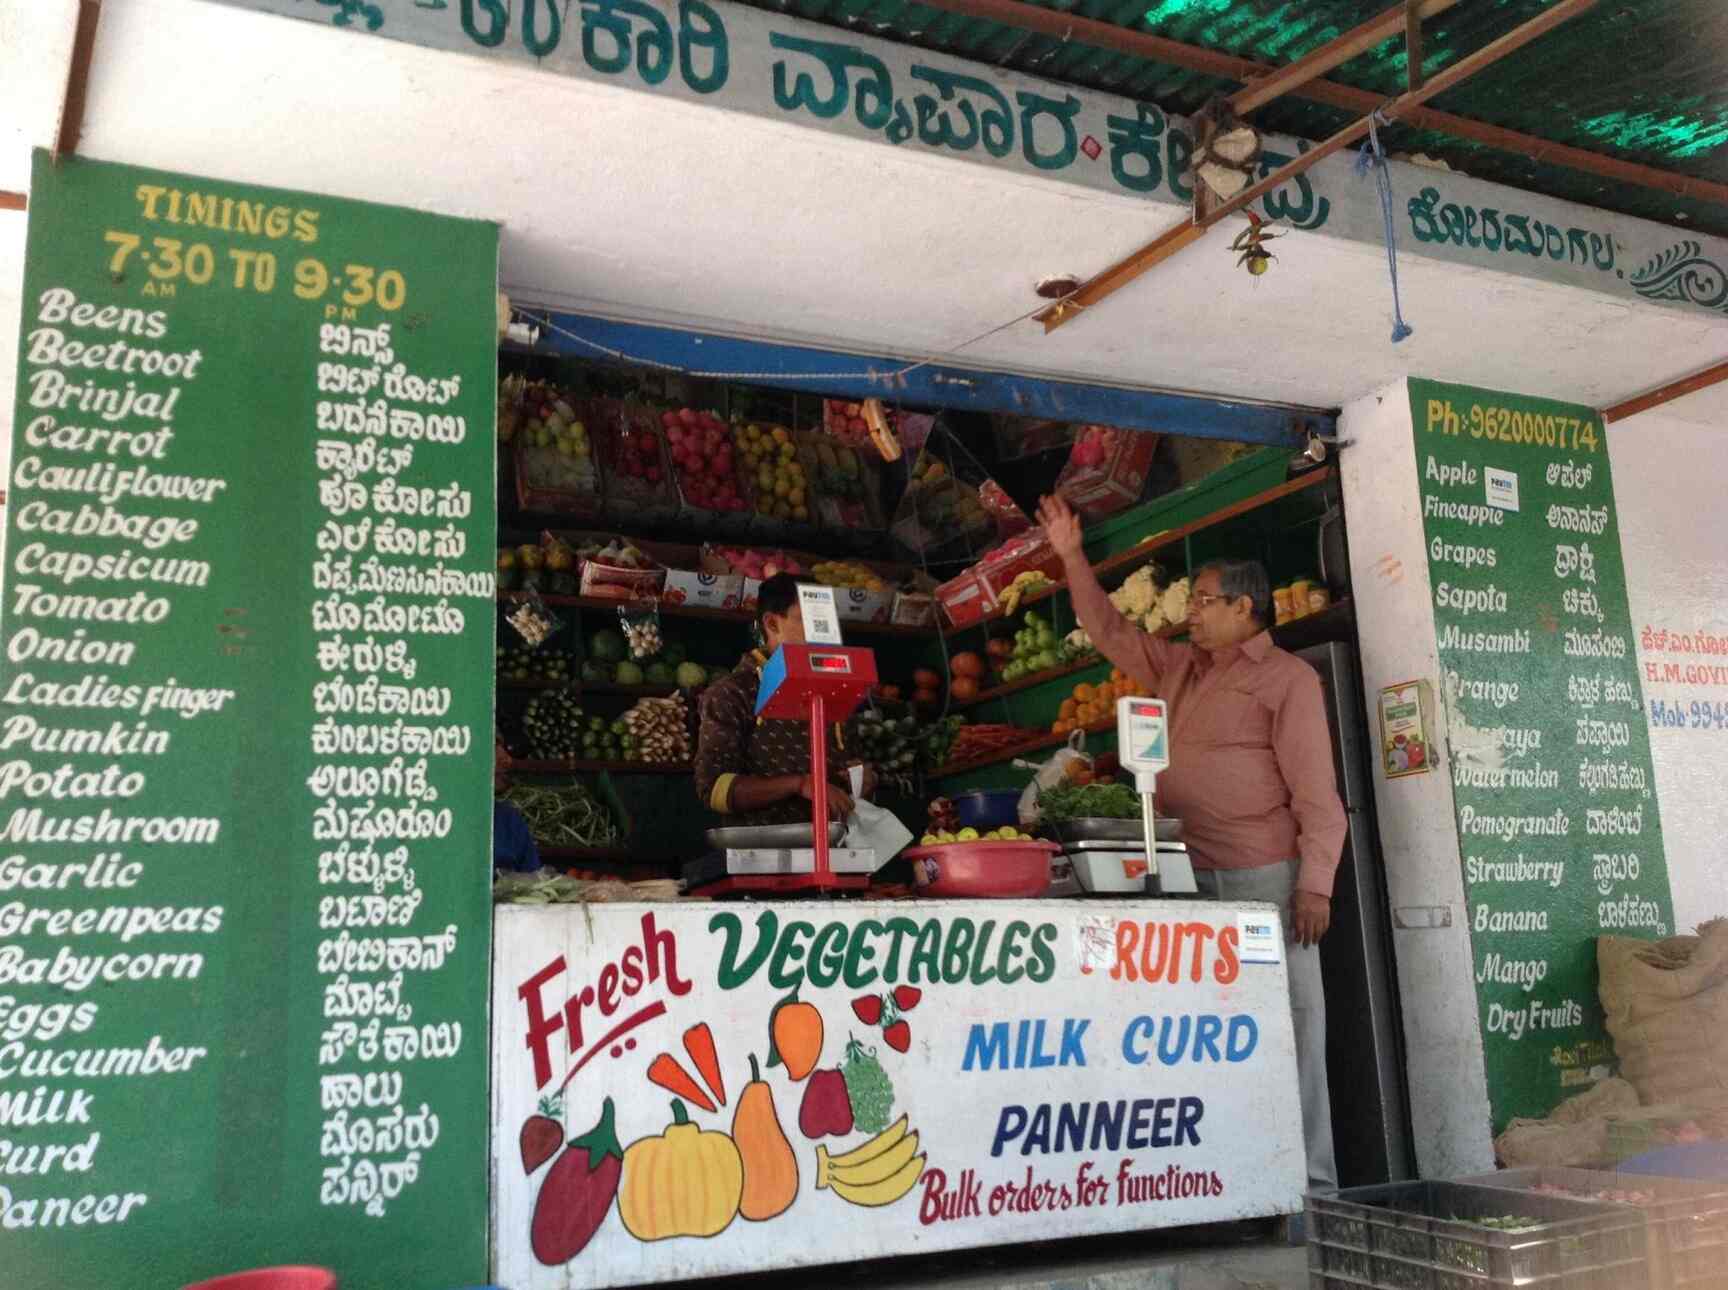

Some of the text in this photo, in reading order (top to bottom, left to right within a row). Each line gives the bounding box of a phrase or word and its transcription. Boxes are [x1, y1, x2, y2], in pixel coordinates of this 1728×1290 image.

[136, 184, 321, 242] TIMINGS
[142, 281, 176, 297] AM
[228, 249, 276, 293] TO
[39, 287, 168, 338] Beens
[325, 304, 358, 321] PM
[27, 328, 202, 379] Beetroot
[28, 369, 181, 421] Brinjal
[24, 415, 174, 459] Carrot
[316, 398, 466, 444] ಬದನೆಕಾಯಿ
[1425, 456, 1478, 487] Apple
[16, 501, 198, 549] Cabbage
[14, 543, 211, 586] Capsicum
[1430, 537, 1497, 567] Grapes
[12, 584, 170, 624] Tomato
[1437, 583, 1507, 616] Sapota
[7, 628, 135, 666] Onion
[1438, 625, 1531, 653] Musambi
[3, 672, 142, 710] Ladies
[0, 714, 170, 754] Pumkin
[0, 759, 146, 799] Potato
[0, 807, 220, 843] Mushroom
[0, 852, 144, 890] Garlic
[1467, 854, 1565, 888] Strawberry
[0, 901, 224, 942] Greenpeas
[1474, 904, 1549, 932] Banana
[0, 945, 204, 991] Babycorn
[708, 909, 1240, 990] VEGETABLES RUITS
[1476, 953, 1547, 992] Mango
[517, 910, 693, 1091] Fresh
[961, 1014, 1259, 1072] MILK CURD
[320, 1071, 403, 1110] ಹಾಲು
[990, 1096, 1205, 1158] PANNEER
[918, 1157, 1224, 1226] Bulk orders for functions
